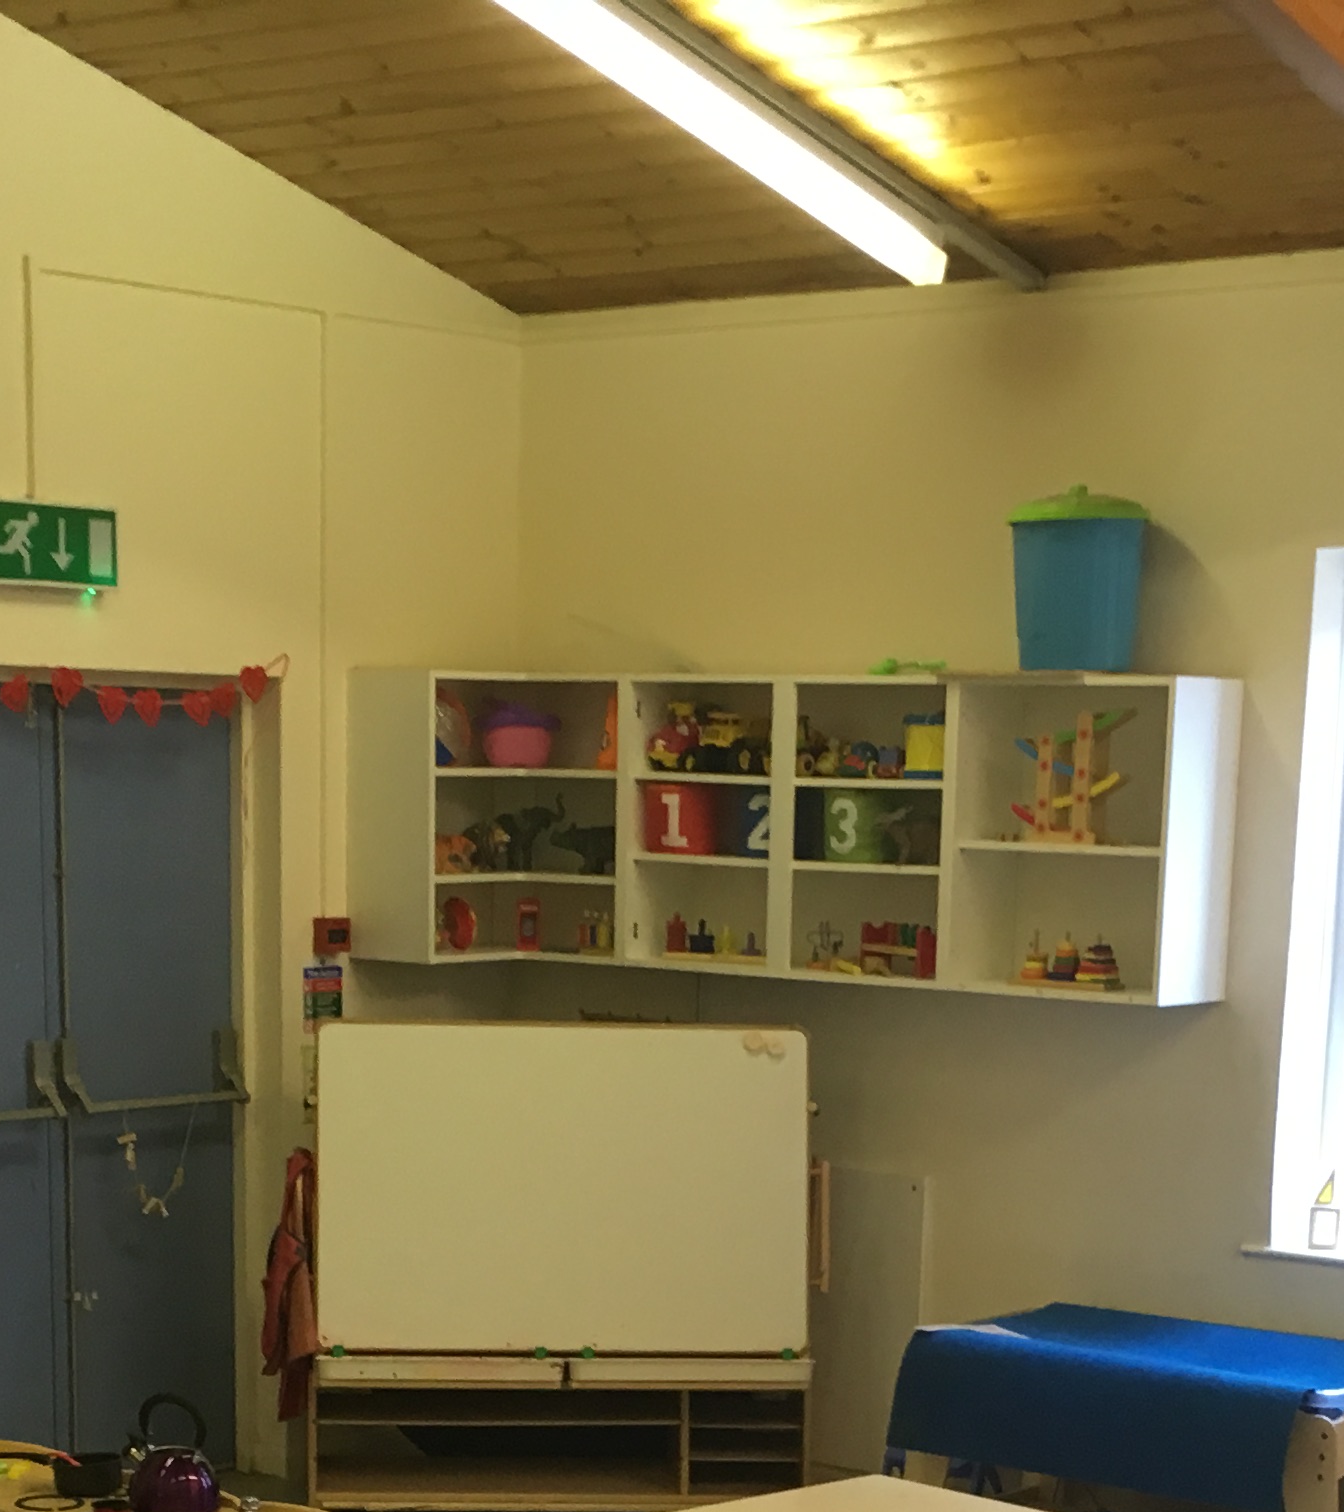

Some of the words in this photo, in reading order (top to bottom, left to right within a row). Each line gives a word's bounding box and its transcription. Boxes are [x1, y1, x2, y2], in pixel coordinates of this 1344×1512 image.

[660, 793, 688, 847] 1
[747, 794, 770, 850] 2
[829, 798, 858, 854] 3
